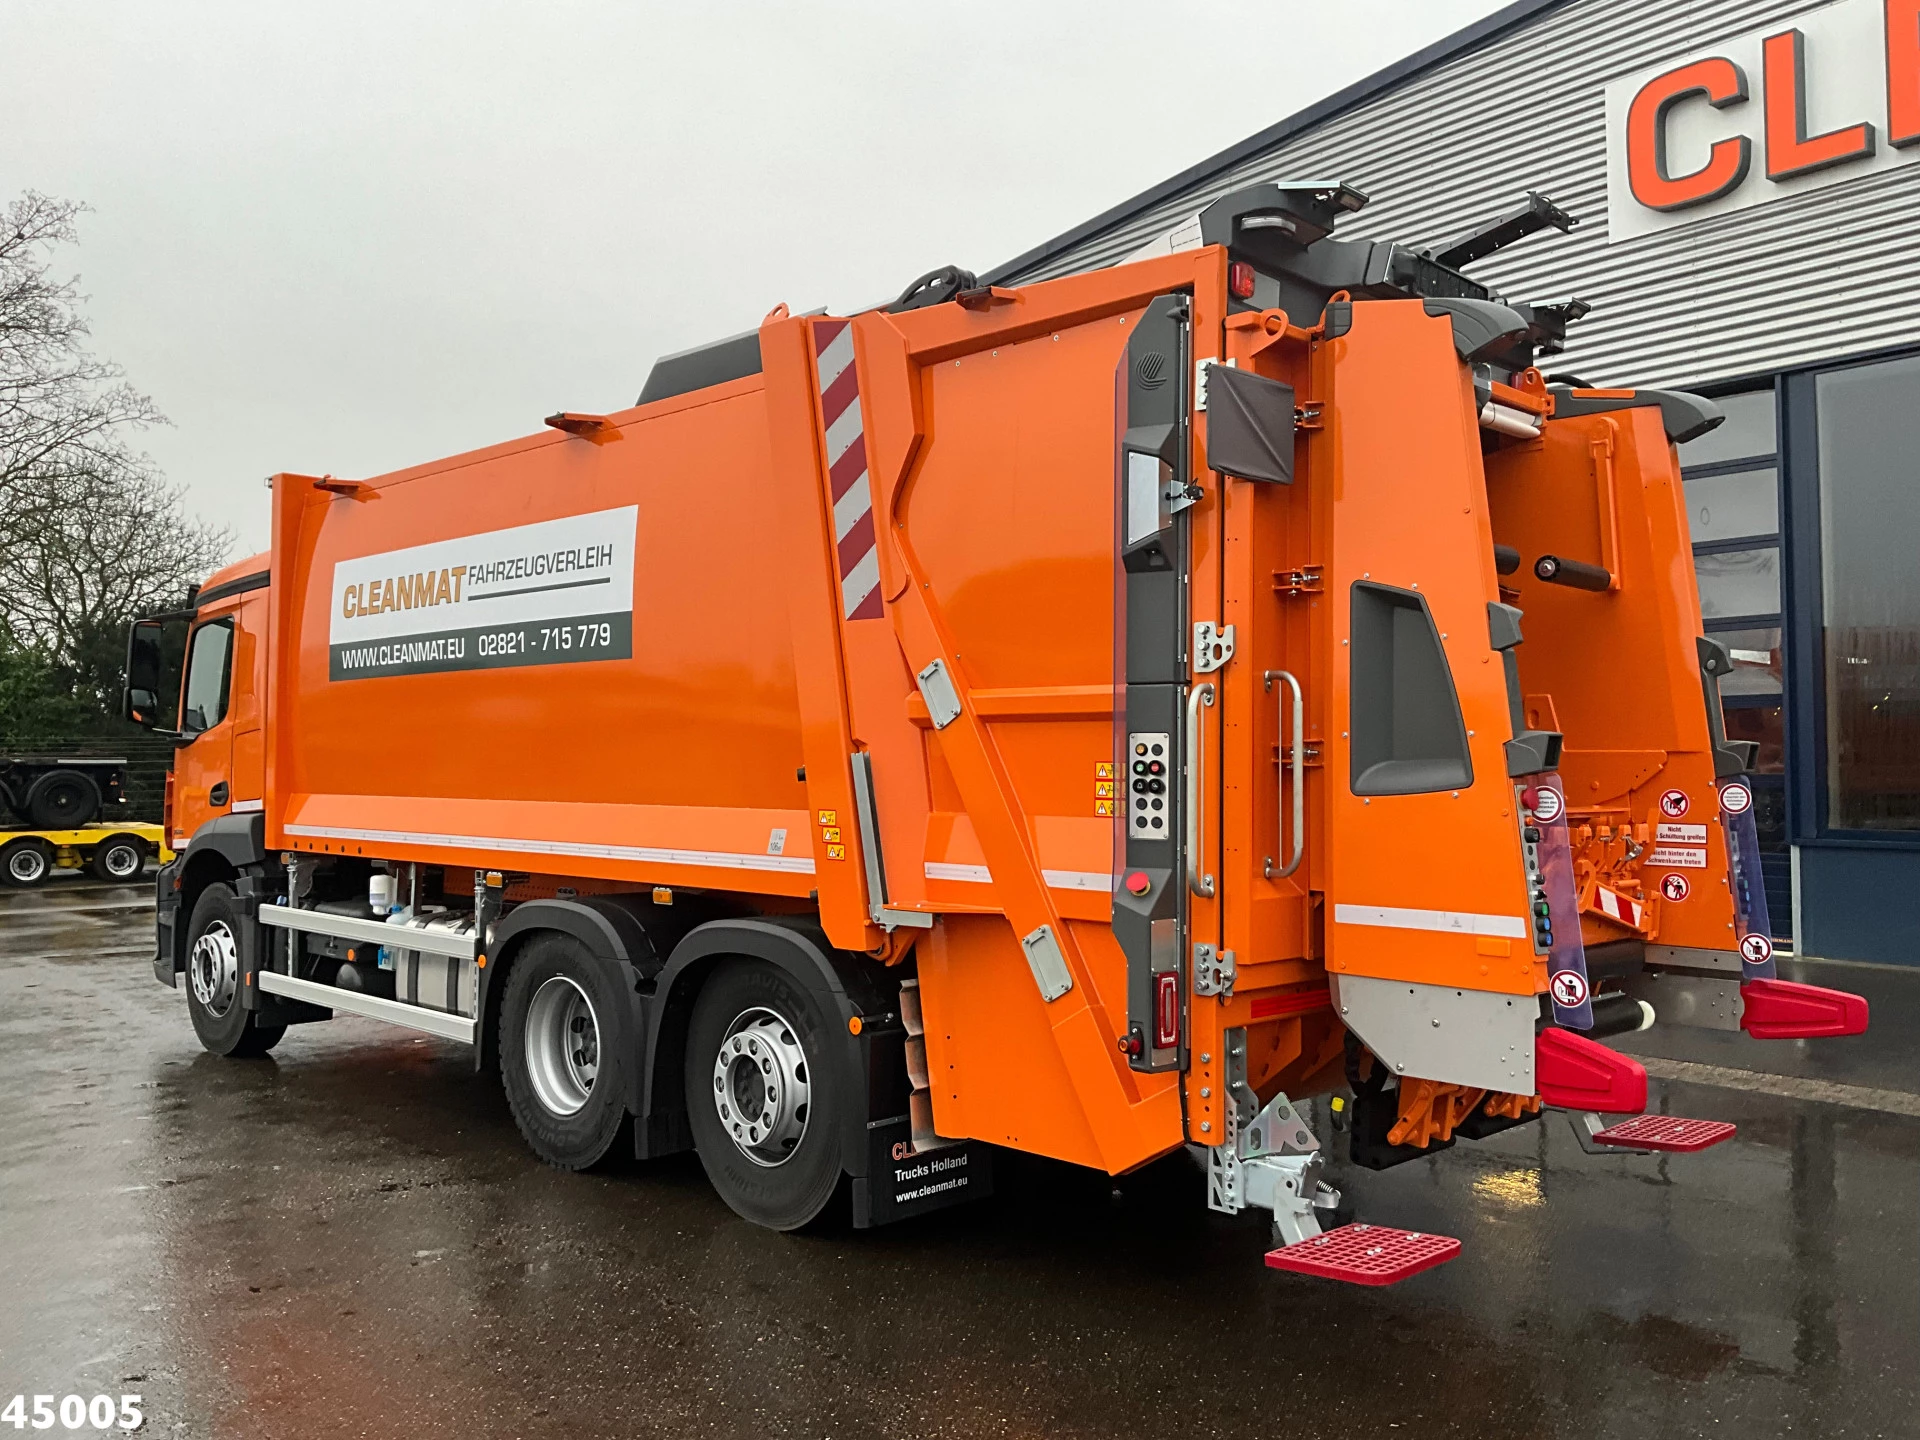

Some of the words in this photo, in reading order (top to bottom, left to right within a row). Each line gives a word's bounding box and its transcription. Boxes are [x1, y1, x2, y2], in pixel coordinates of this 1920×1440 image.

[342, 565, 467, 619] CLEANMAT
[467, 544, 613, 586] FAHRZEUGVERLEIH
[341, 638, 465, 669] WWW.CLEANMAT.EU
[478, 631, 525, 656] 02821
[540, 626, 572, 651] 715
[577, 623, 611, 647] 779
[894, 1164, 929, 1182] Trucks
[931, 1154, 968, 1174] Holland
[895, 1176, 968, 1203] www.cleanmat.eu
